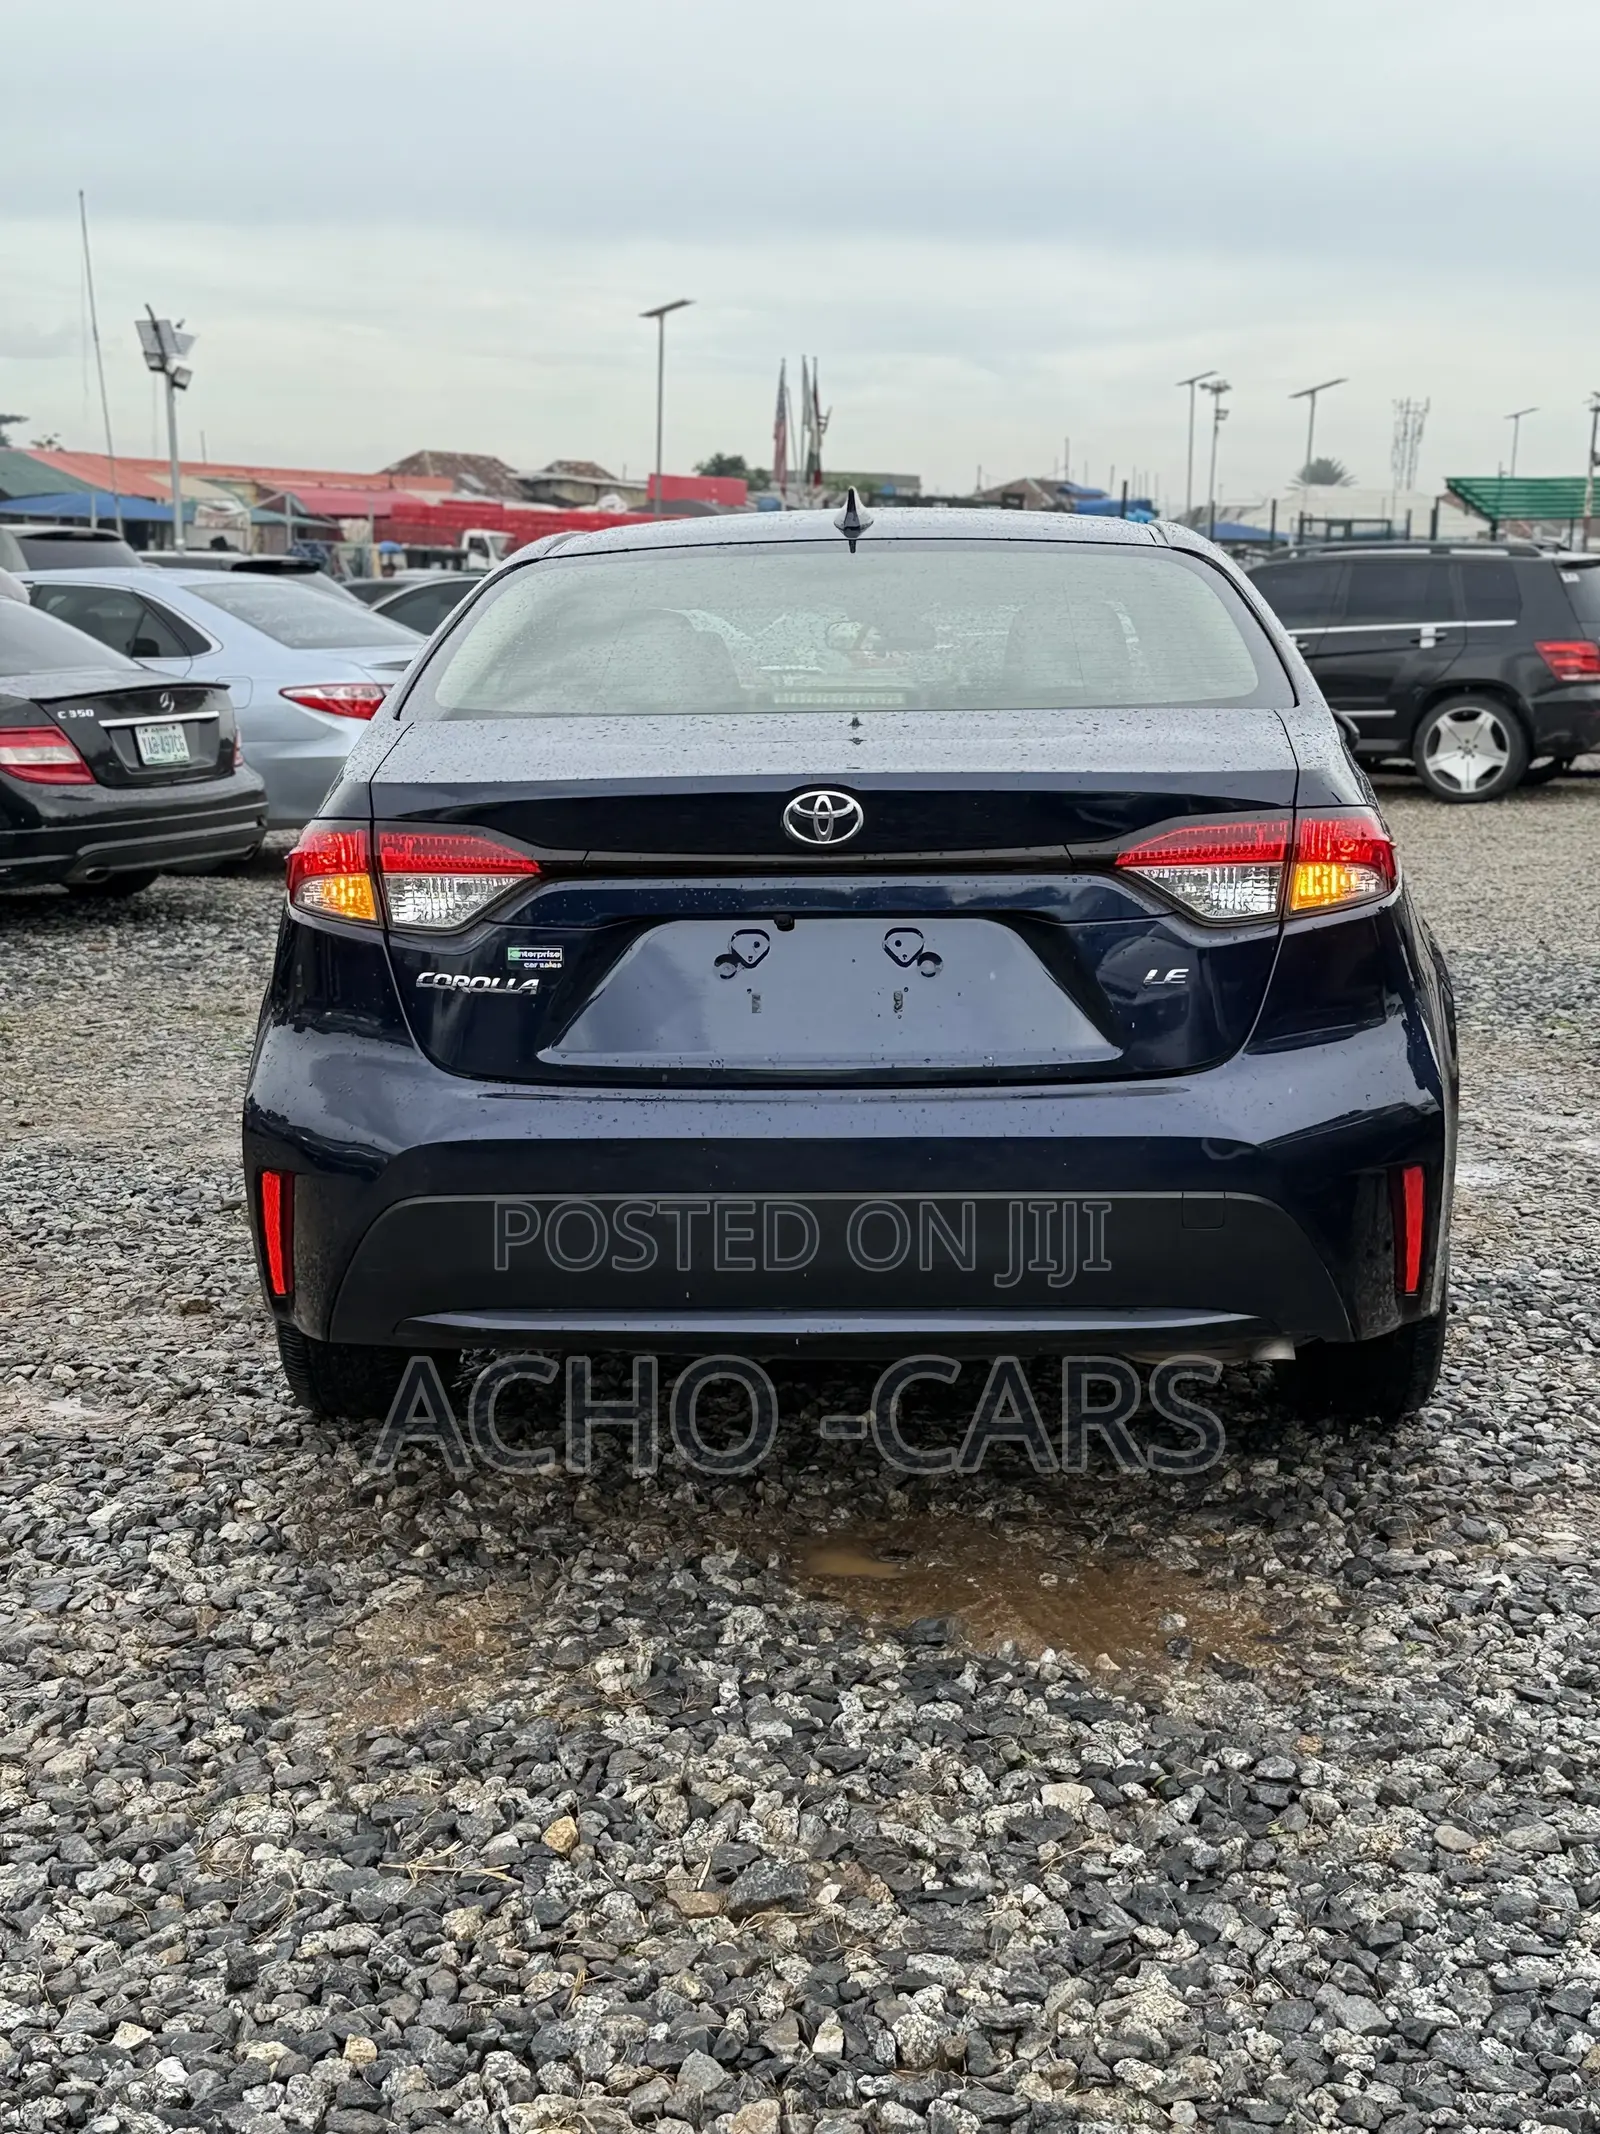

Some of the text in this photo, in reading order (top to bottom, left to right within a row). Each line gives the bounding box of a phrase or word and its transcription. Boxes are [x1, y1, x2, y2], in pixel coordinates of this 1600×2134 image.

[58, 709, 95, 719] C 350
[416, 972, 540, 995] COROLLA
[1143, 968, 1189, 985] LE
